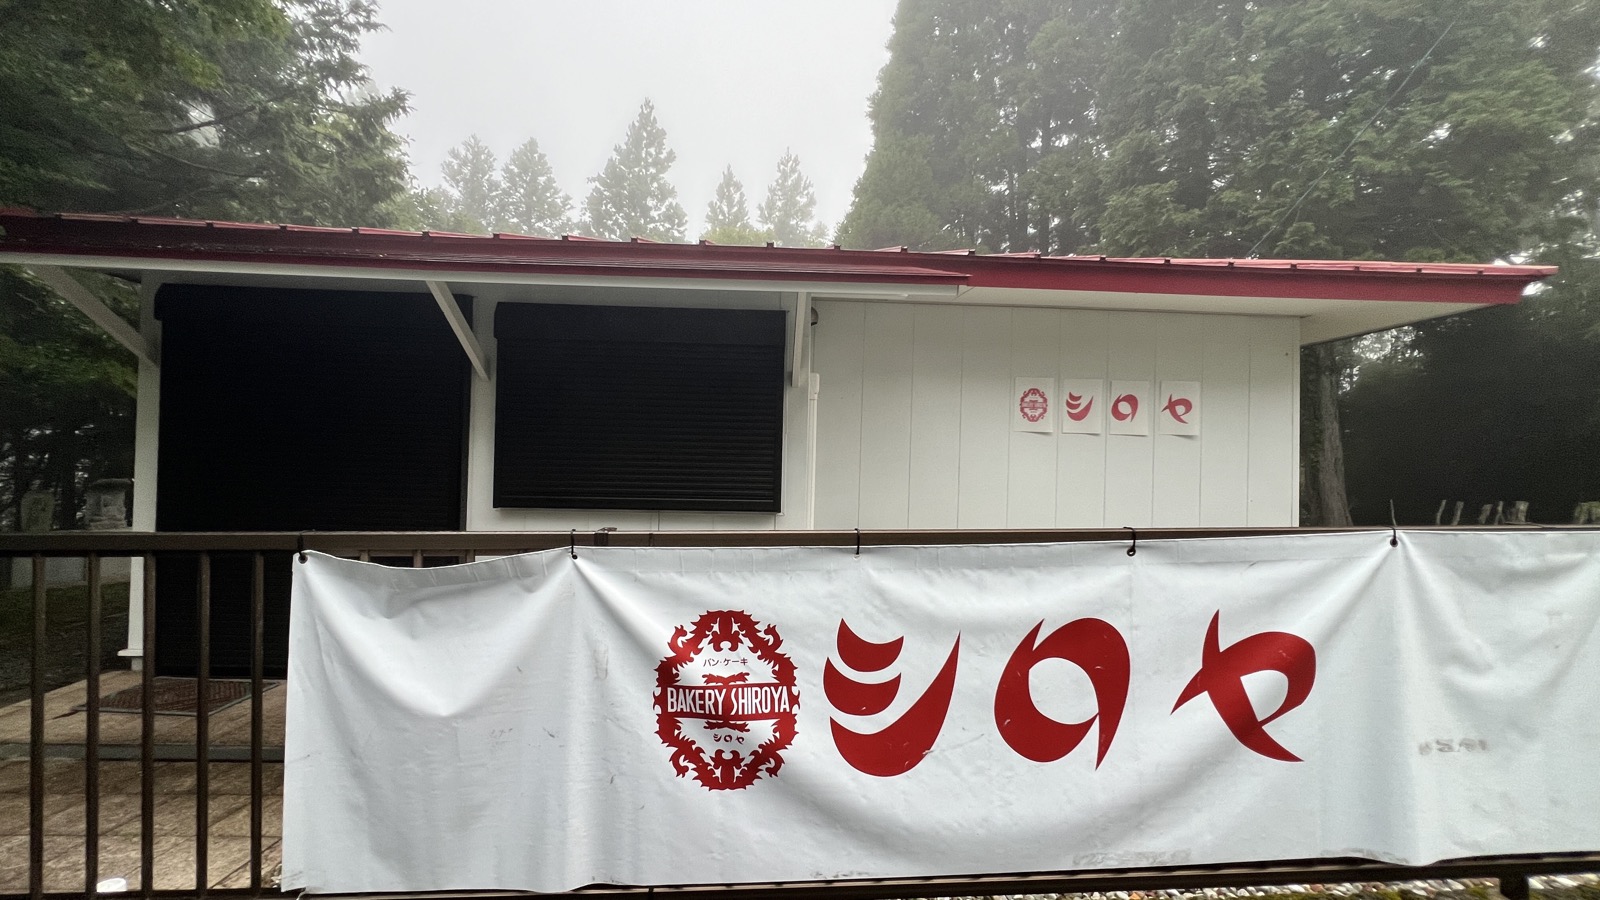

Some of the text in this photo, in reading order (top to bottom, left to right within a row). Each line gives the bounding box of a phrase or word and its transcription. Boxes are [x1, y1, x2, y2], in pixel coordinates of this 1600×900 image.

[667, 686, 790, 715] BAKERY SHIROYA
[823, 609, 1316, 777] シロヤ
